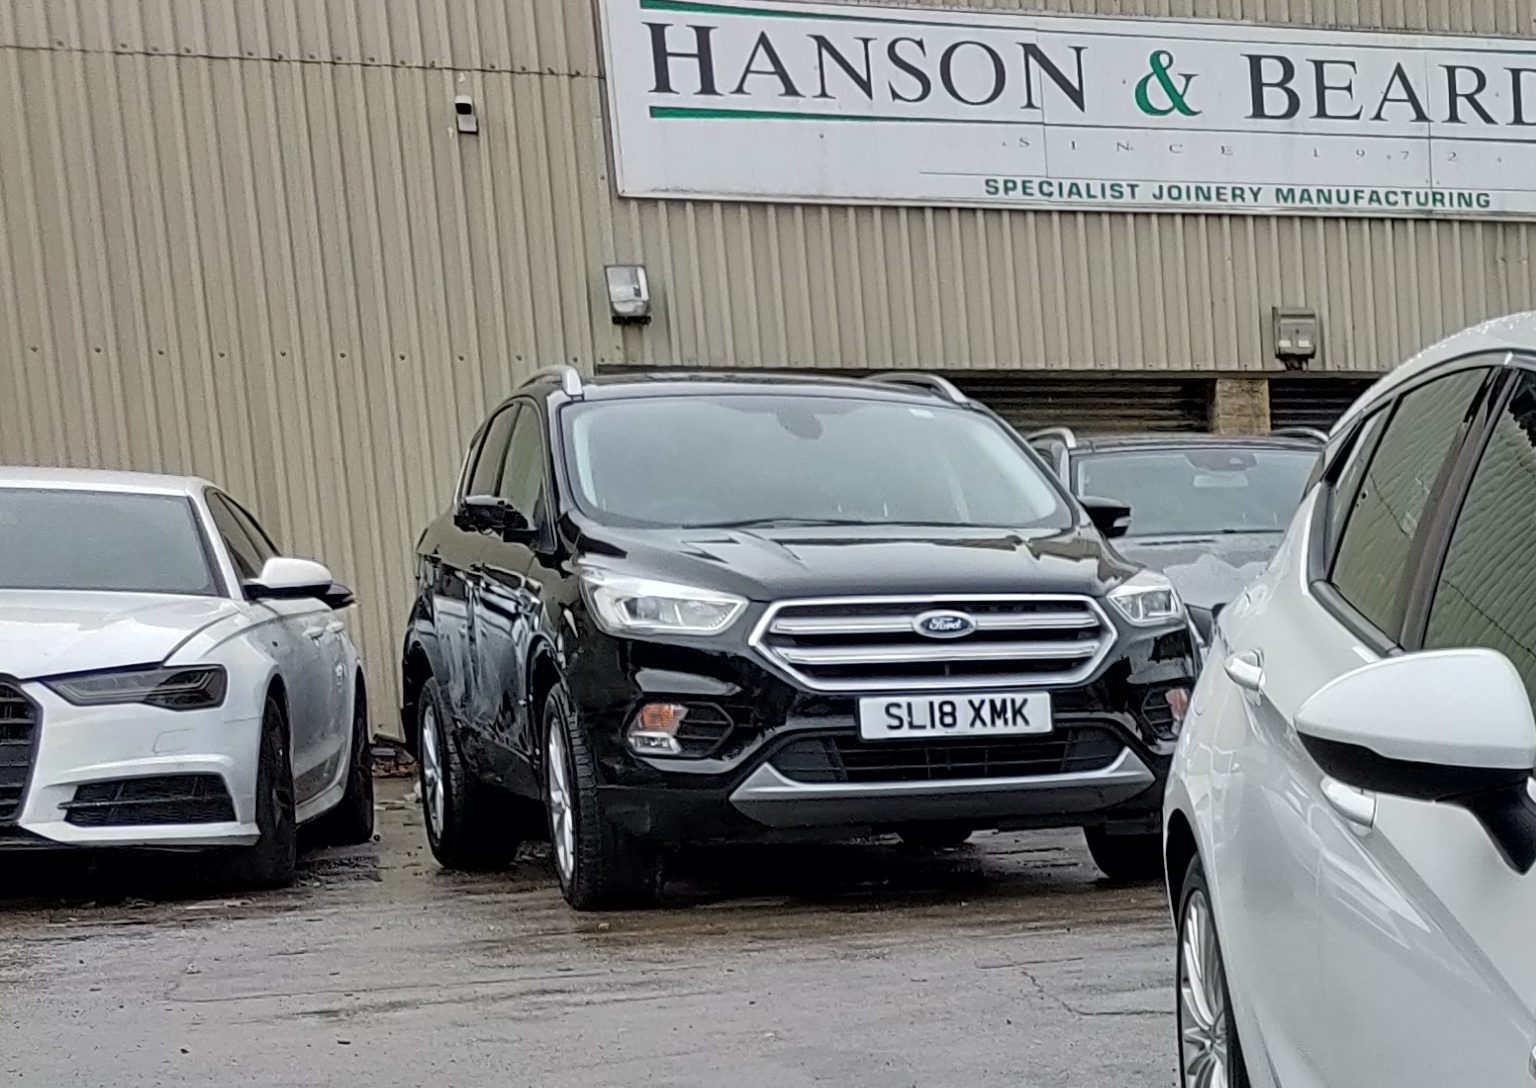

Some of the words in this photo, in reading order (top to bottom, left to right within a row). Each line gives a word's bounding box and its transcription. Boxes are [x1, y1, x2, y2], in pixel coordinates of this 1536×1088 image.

[641, 21, 1089, 113] HANSON
[1134, 49, 1202, 118] &
[984, 178, 1141, 201] SPECIALIST
[1152, 183, 1263, 204] JOINERY
[1275, 187, 1492, 210] MANUFACTURING
[929, 617, 962, 630] Ford
[884, 700, 958, 731] SL18
[967, 697, 1030, 728] XMK
